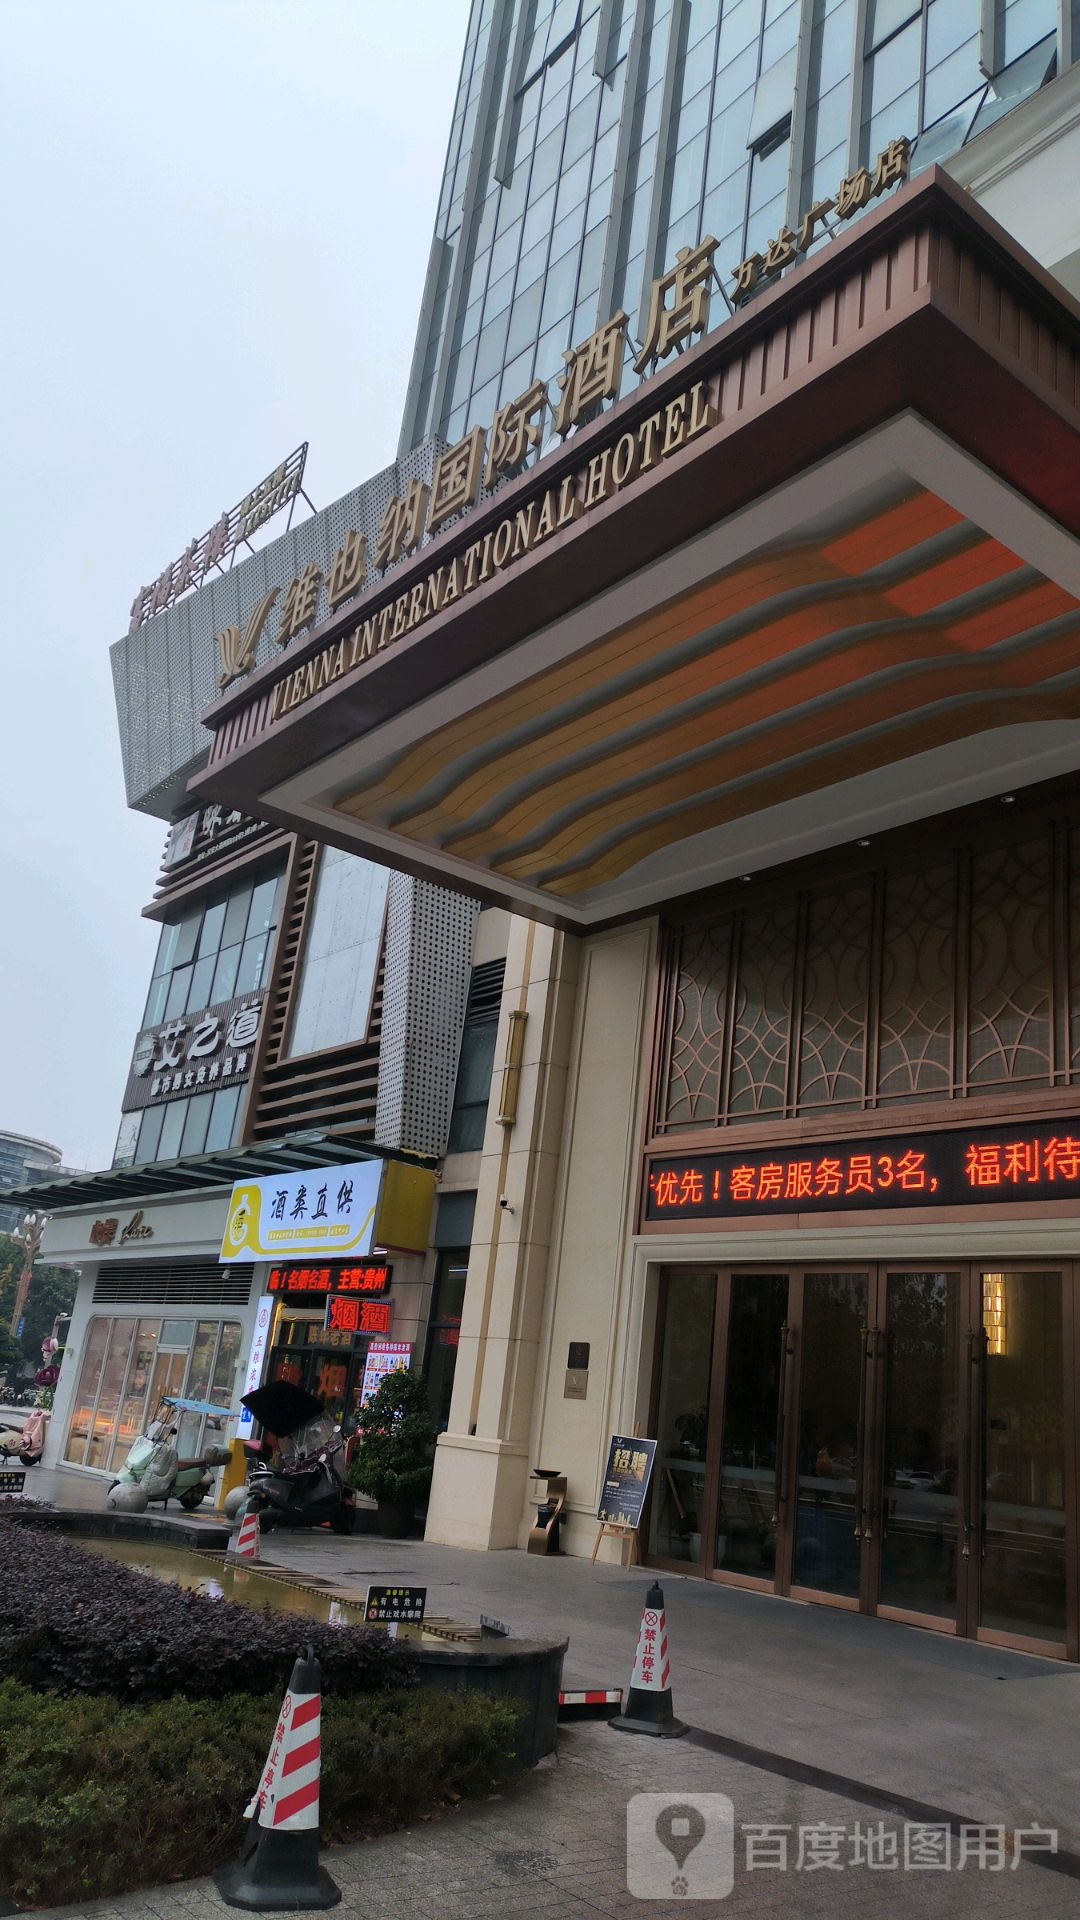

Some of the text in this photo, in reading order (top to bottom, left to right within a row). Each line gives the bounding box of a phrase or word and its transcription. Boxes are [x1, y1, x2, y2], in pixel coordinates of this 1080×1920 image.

[277, 234, 720, 646] 维也纳国际酒店
[730, 134, 911, 302] 万达广场店
[271, 637, 350, 723] VIENNA
[350, 473, 582, 667] INTERNATIONAL
[583, 380, 717, 507] HOTEL
[153, 999, 262, 1071] 艾之道
[329, 1298, 391, 1333] 烟酒
[613, 1448, 648, 1472] 招聘
[641, 1628, 657, 1684] 禁止停车
